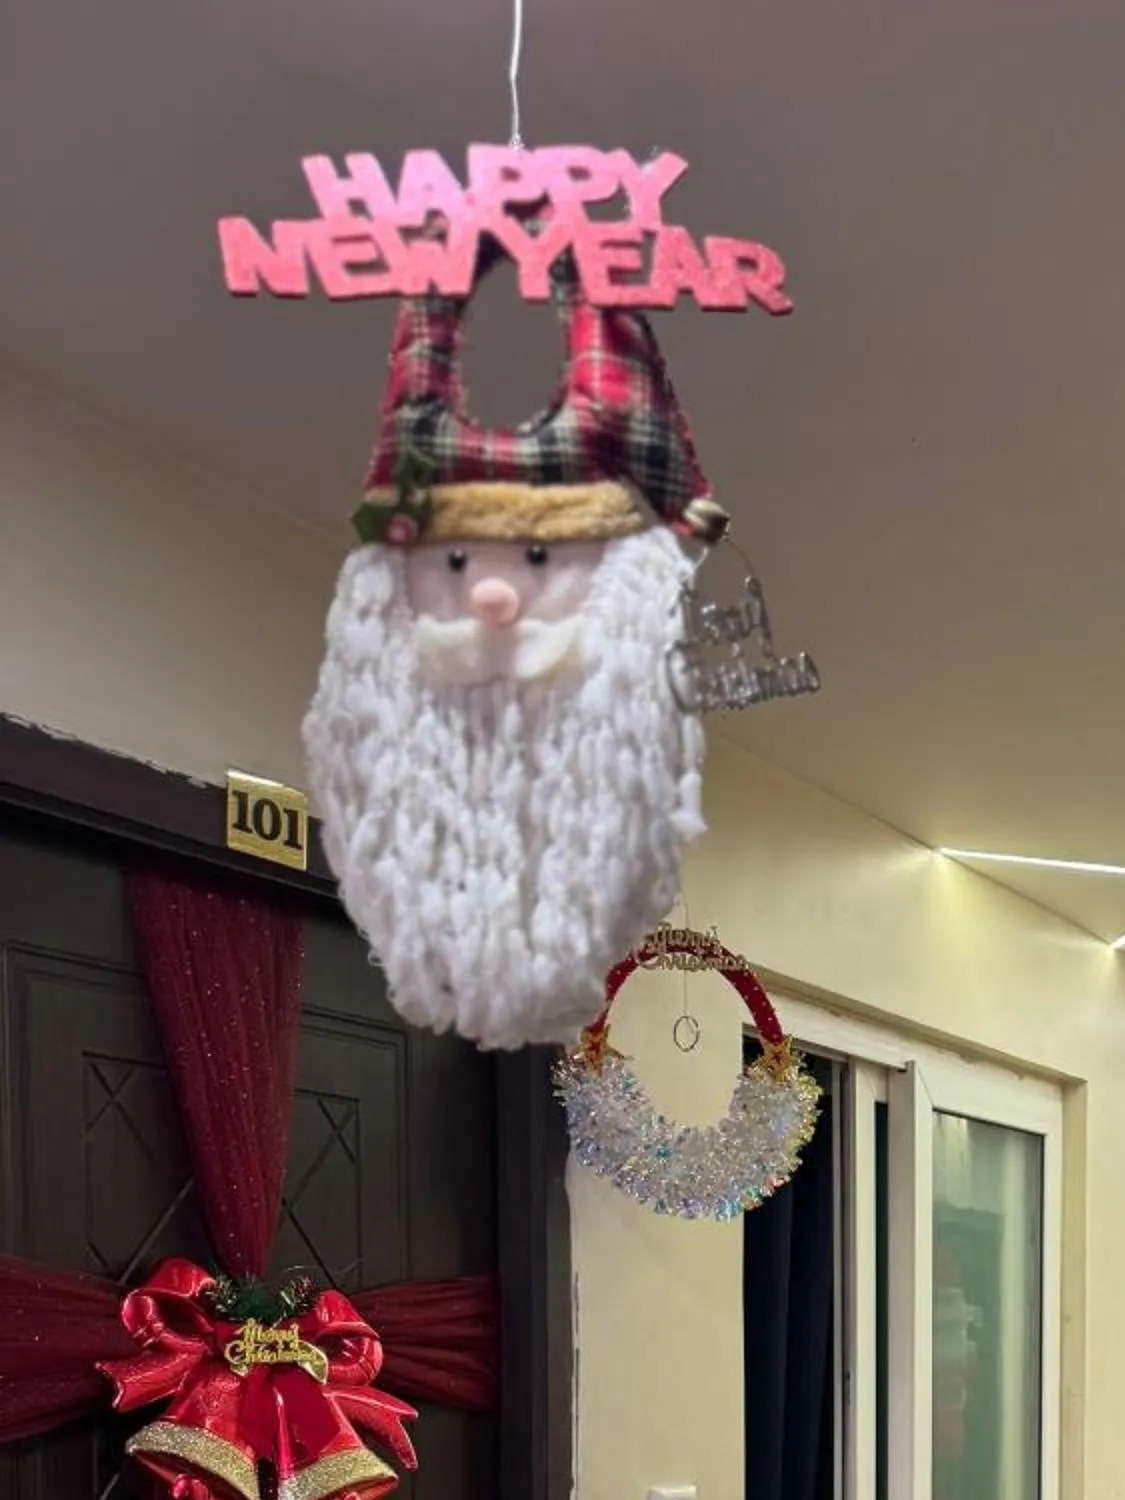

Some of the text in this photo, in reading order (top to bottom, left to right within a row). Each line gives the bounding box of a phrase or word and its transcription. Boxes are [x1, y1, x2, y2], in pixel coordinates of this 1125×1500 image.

[301, 142, 690, 234] HAPPY
[216, 210, 795, 316] NEW YEAR
[231, 789, 304, 851] 101
